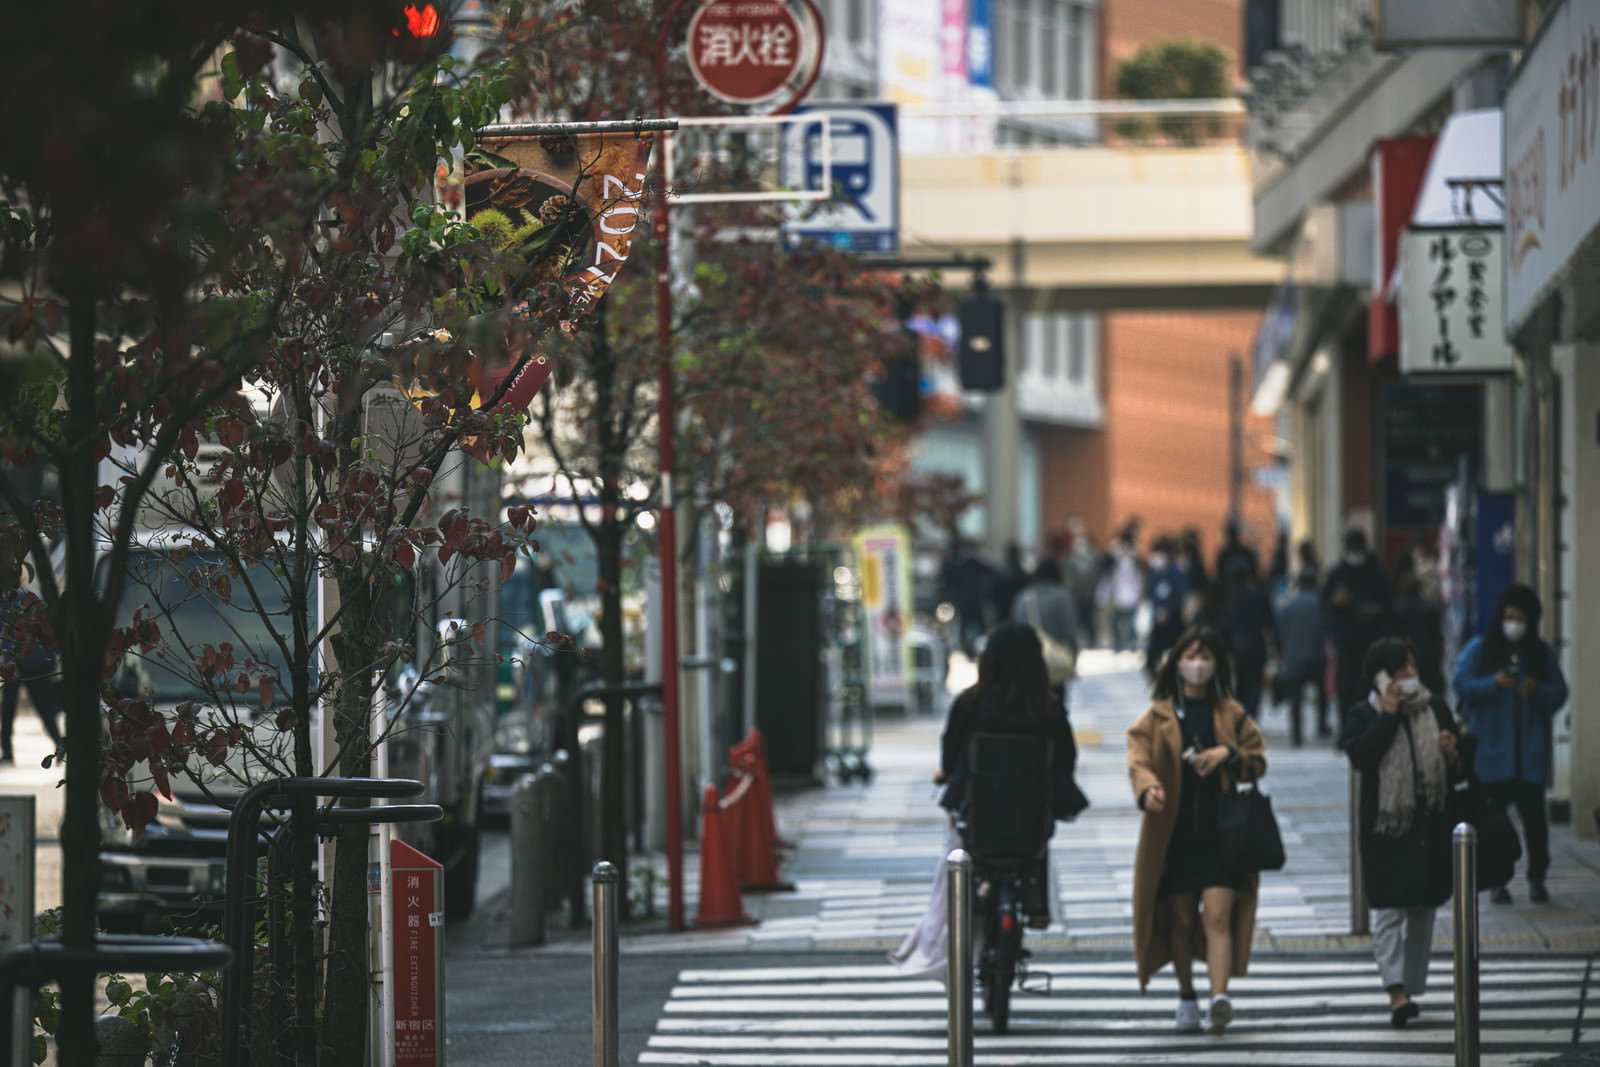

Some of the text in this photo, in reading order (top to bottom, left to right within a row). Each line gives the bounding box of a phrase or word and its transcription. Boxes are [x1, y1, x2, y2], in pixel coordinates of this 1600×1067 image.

[700, 23, 793, 67] 消火栓
[586, 173, 645, 284] 2021
[407, 875, 420, 928] 消火器
[410, 930, 419, 1017] FIRE EXTINGUISHER
[396, 1019, 434, 1031] 新宿区
